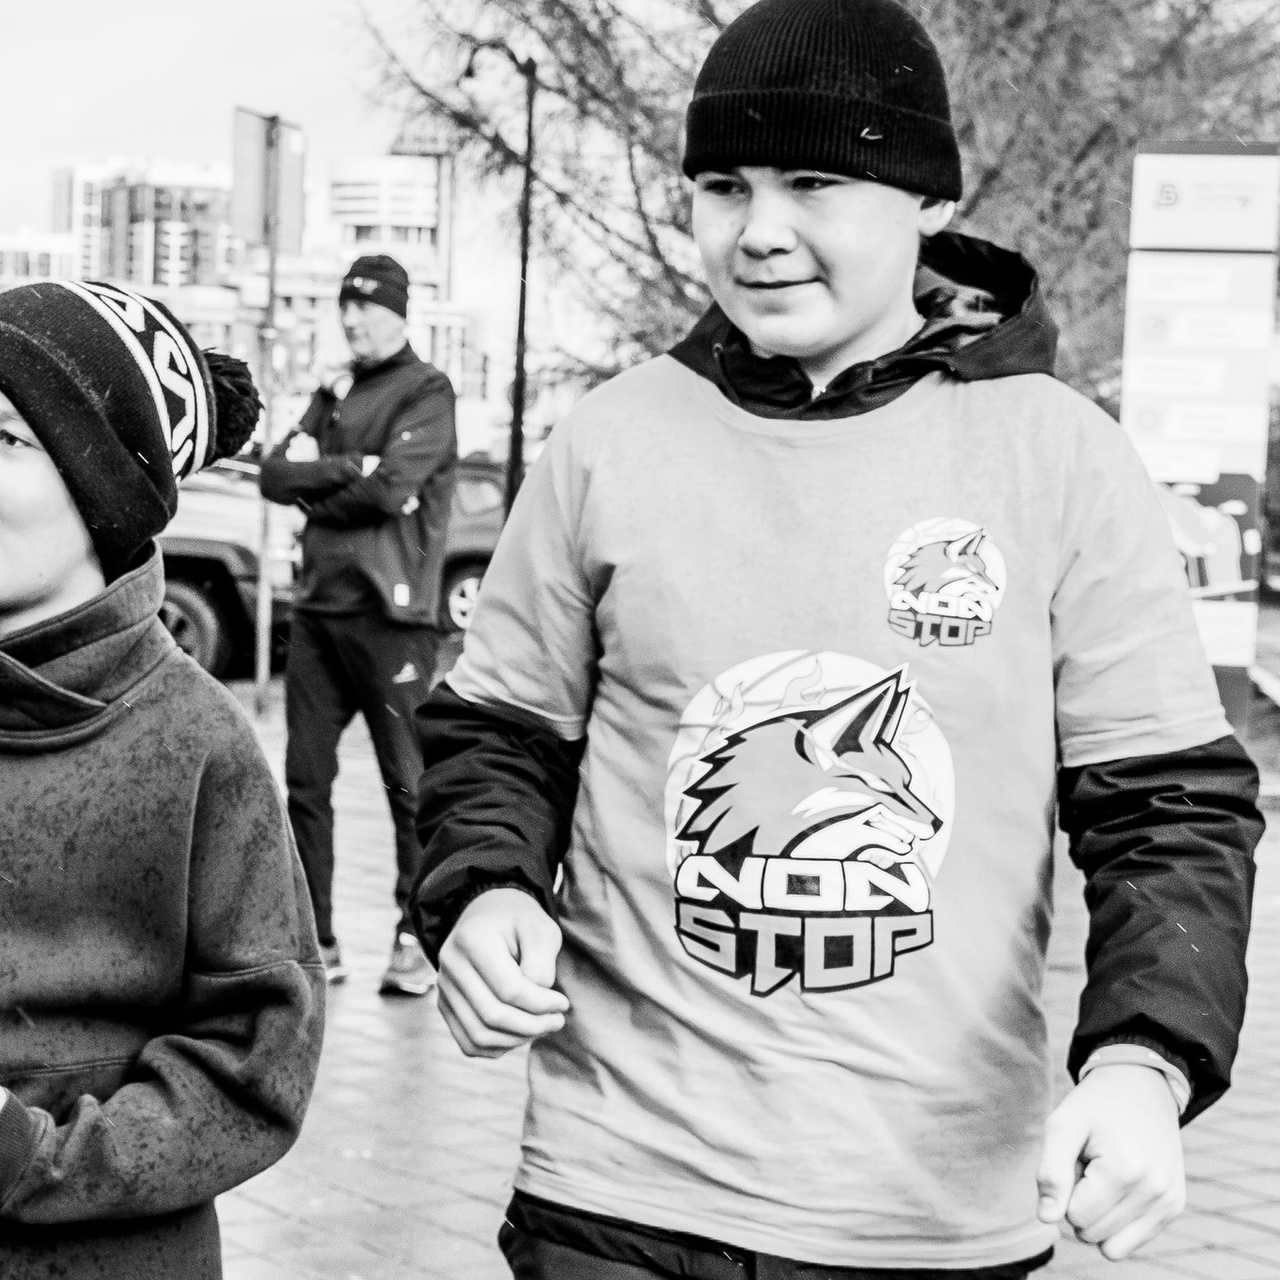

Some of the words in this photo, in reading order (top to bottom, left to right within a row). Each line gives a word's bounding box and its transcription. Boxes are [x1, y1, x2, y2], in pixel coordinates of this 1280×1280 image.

[887, 608, 992, 647] STOP
[890, 590, 994, 623] NON
[675, 854, 931, 913] NON
[674, 898, 934, 998] STOP
